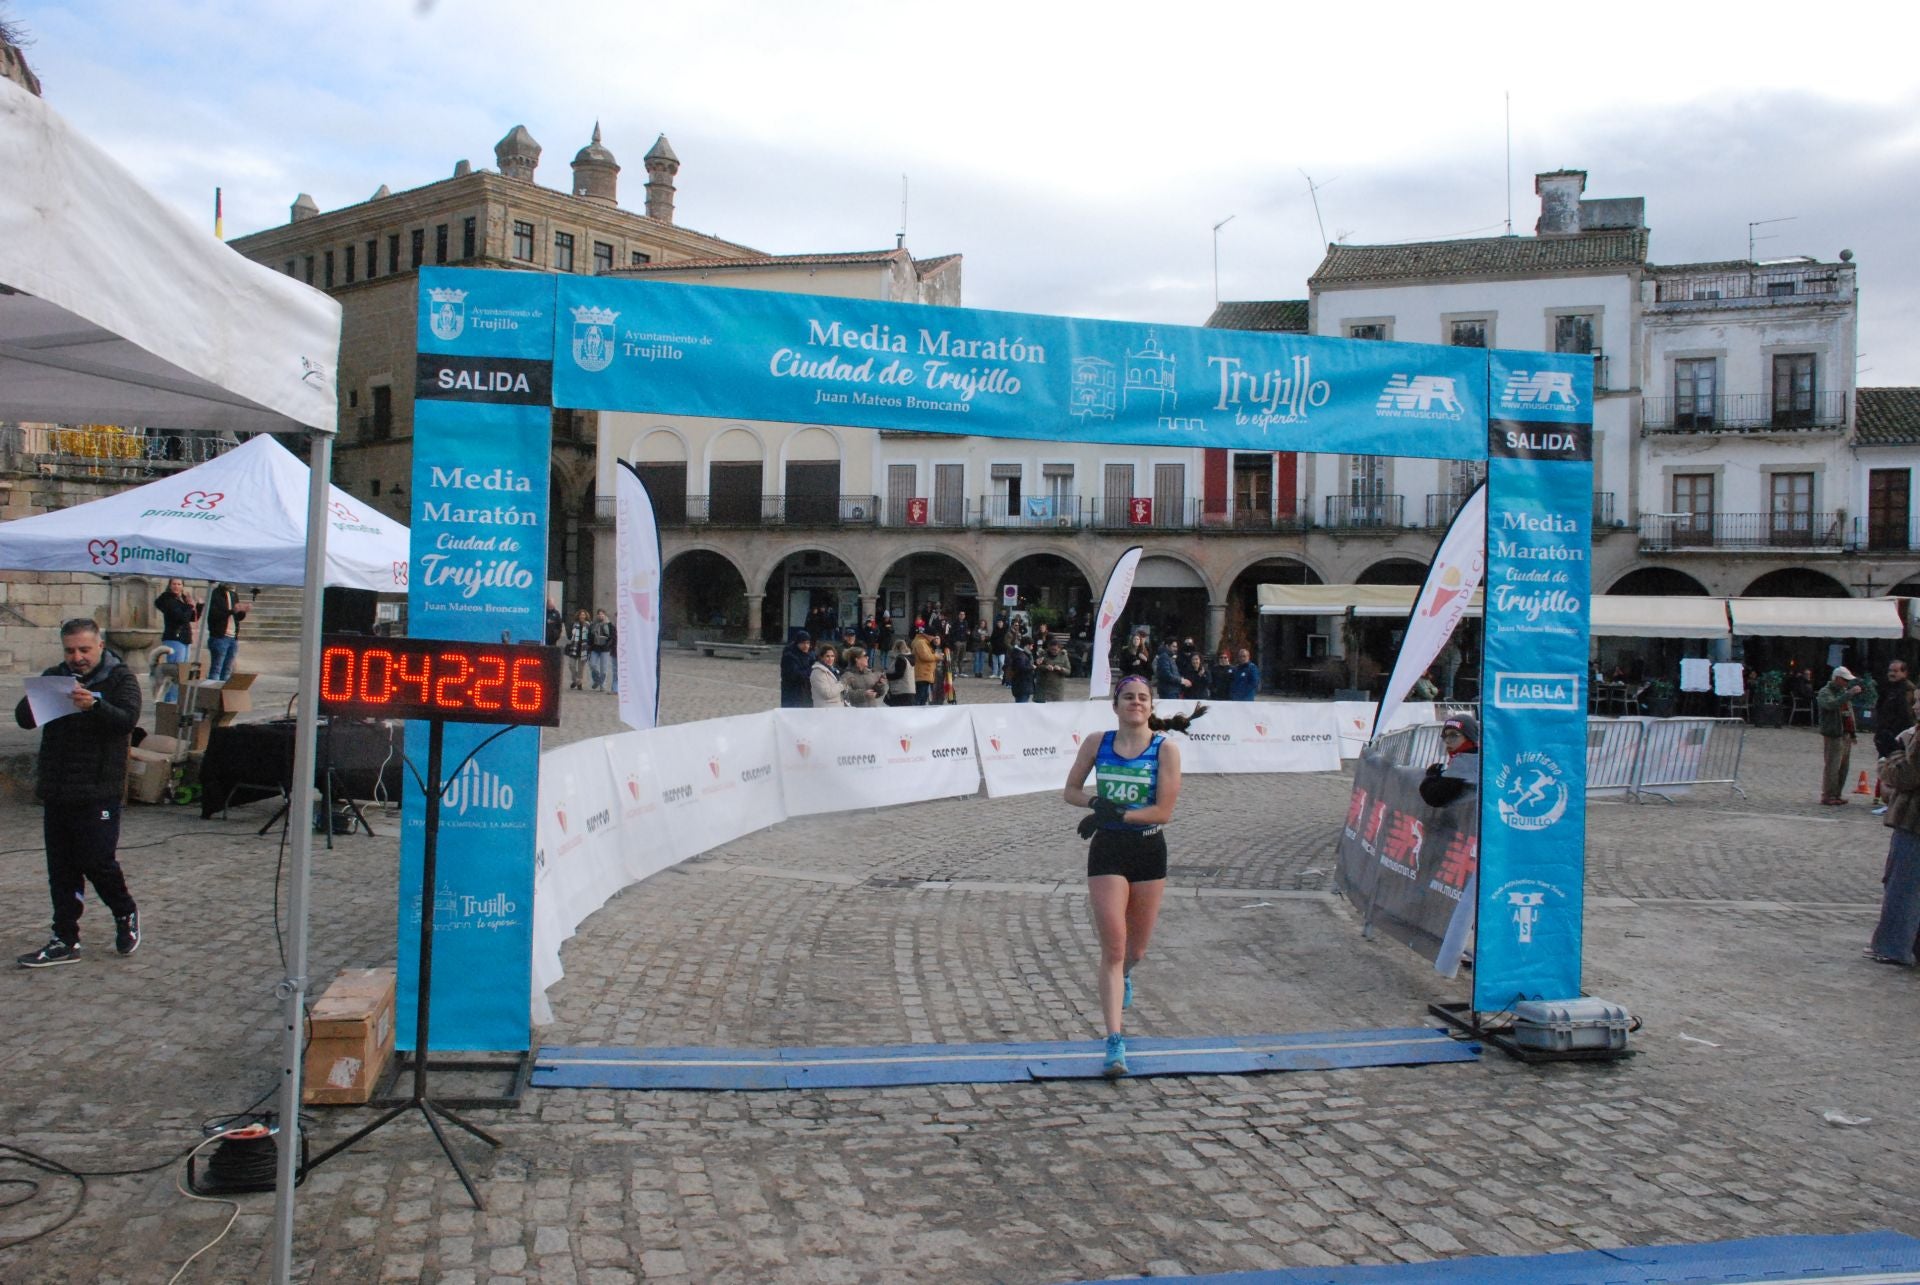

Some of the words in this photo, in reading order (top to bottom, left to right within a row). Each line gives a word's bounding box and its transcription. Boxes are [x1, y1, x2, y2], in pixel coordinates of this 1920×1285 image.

[471, 306, 531, 318] Ayuntamiento
[531, 310, 543, 318] de
[471, 317, 519, 332] Trujillo
[624, 330, 698, 347] Ayuntamiento
[699, 335, 713, 346] de
[807, 318, 908, 353] Media
[918, 328, 1046, 364] Maratón
[622, 342, 683, 362] Trujillo
[438, 368, 531, 393] SALIDA
[770, 348, 875, 384] Ciudad
[878, 359, 917, 386] de
[922, 360, 1022, 401] Trujillo
[1207, 354, 1331, 418] Trujillo
[814, 388, 848, 405] Juan
[852, 391, 902, 408] Mateos
[906, 396, 970, 413] Broncano
[1501, 400, 1576, 411] www.musicrun.es
[1234, 405, 1249, 427] te
[1376, 407, 1461, 421] www.musicrun.es
[1506, 430, 1576, 452] SALIDA
[430, 466, 532, 492] Media
[140, 508, 225, 521] primaflor
[422, 501, 537, 526] Maratón
[1502, 511, 1578, 533] Media
[437, 532, 497, 551] Ciudad
[498, 537, 521, 552] de
[1497, 540, 1584, 561] Maratón
[120, 545, 192, 565] primaflor
[420, 553, 533, 599] Trujillo
[1506, 566, 1549, 583] Ciudad
[1551, 570, 1569, 583] de
[424, 601, 447, 612] Juan
[450, 602, 482, 613] Mateos
[485, 603, 529, 614] Broncano
[1494, 584, 1580, 622] Trujillo
[321, 648, 543, 711] 00:42:26
[1505, 683, 1566, 700] HABLA
[1496, 762, 1512, 789] Club
[1515, 751, 1562, 776] Atletismo
[1105, 781, 1139, 801] 246
[1143, 827, 1157, 836] NIKE
[459, 892, 516, 918] Trujillo
[476, 917, 486, 929] te
